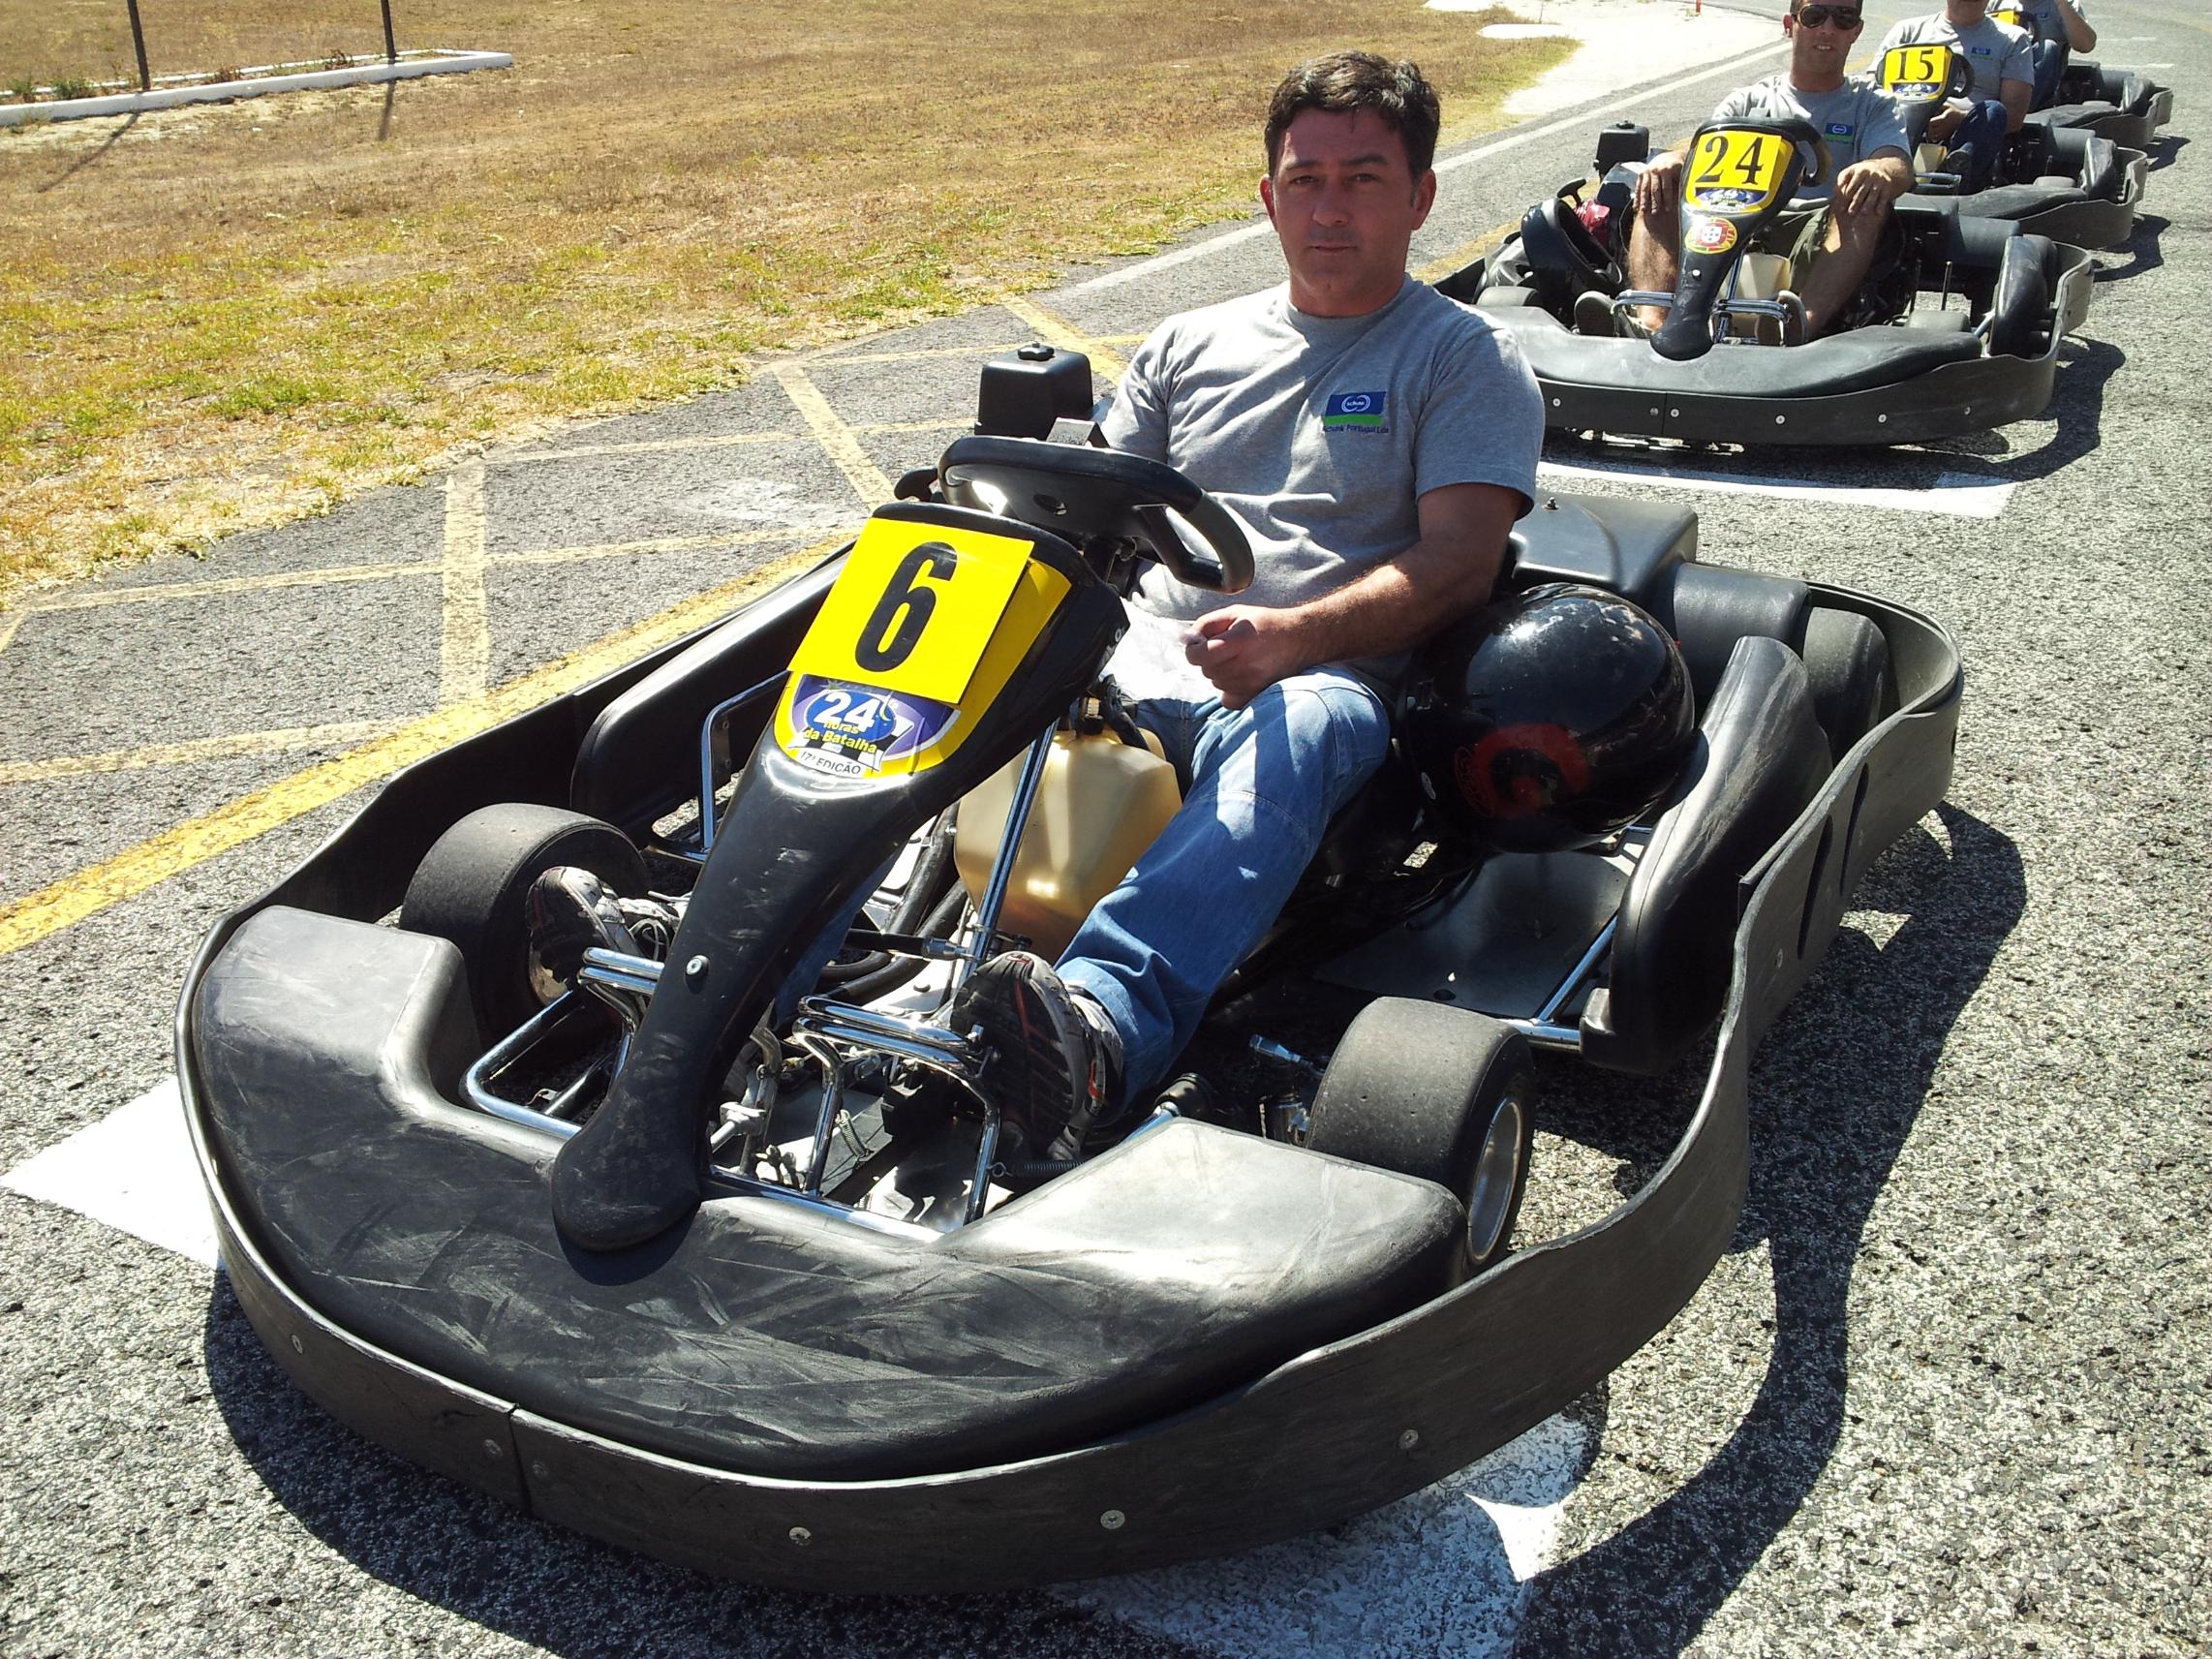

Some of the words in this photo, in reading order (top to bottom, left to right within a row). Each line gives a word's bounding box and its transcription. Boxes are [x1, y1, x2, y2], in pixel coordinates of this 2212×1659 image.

[1895, 48, 1934, 80] 15
[1695, 136, 1764, 185] 24
[855, 541, 958, 672] 6
[813, 691, 880, 732] 24
[804, 727, 820, 740] da
[822, 730, 877, 753] Batalha
